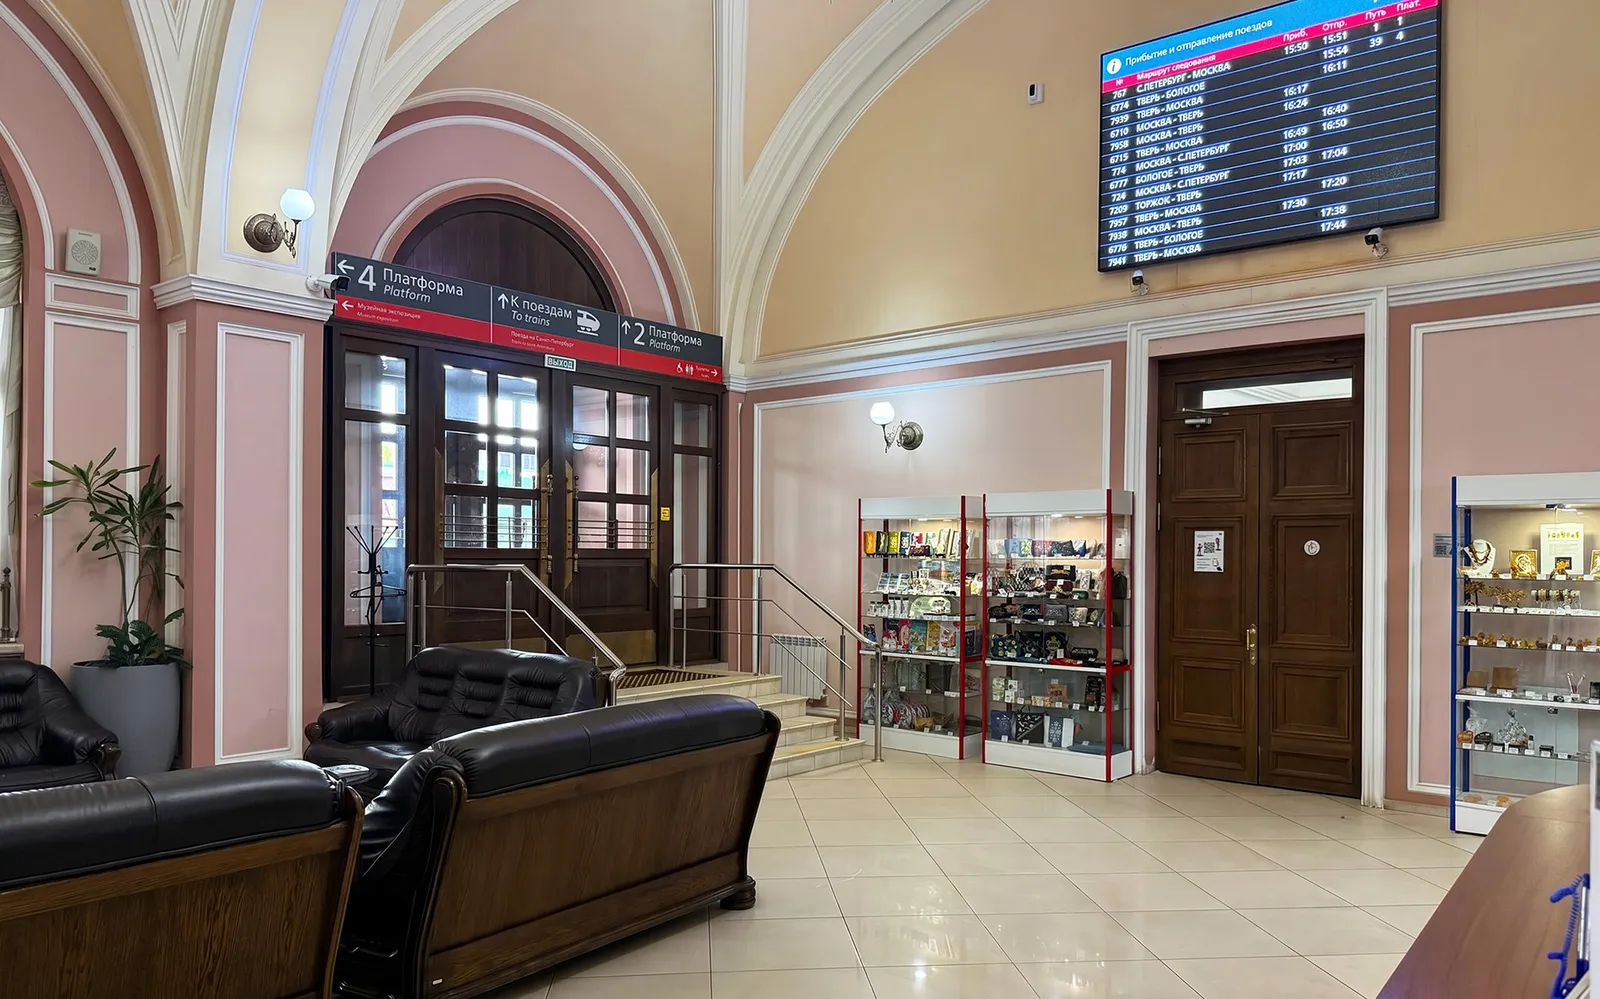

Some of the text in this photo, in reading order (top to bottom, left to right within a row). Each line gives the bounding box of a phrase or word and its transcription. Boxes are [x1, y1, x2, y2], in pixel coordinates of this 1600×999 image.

[1113, 89, 1127, 99] 767
[1136, 73, 1186, 93] С.ПЕТЕРБУРГ
[1192, 62, 1231, 79] МОСКВА
[1284, 41, 1309, 55] 15:50
[1322, 31, 1347, 45] 15:51
[1373, 22, 1379, 32] 1
[1397, 16, 1403, 26] 1
[1125, 49, 1167, 66] Прибытие
[1176, 31, 1233, 52] отправление
[1235, 20, 1272, 36] поездов
[1136, 67, 1171, 81] Маршрут
[1171, 55, 1216, 71] следования
[1283, 29, 1308, 42] Приб.
[1322, 20, 1347, 32] Отпр.
[1365, 9, 1387, 20] Путь
[1396, 0, 1421, 12] Плат.
[1110, 114, 1129, 125] 7939
[1136, 106, 1160, 119] ТВЕРЬ
[1166, 96, 1203, 112] МОСКВА
[1323, 60, 1348, 74] 16:11
[1111, 101, 1129, 113] 6774
[1136, 93, 1160, 107] ТВЕРЬ
[1166, 82, 1205, 99] БОЛОГОЕ
[1322, 45, 1348, 59] 15:54
[1369, 37, 1383, 48] 39
[1395, 31, 1404, 41] 4
[1110, 127, 1129, 138] 6710
[1136, 117, 1172, 132] МОСКВА
[1178, 110, 1203, 123] ТВЕРЬ
[1284, 83, 1308, 97] 16:17
[1110, 141, 1129, 151] 7958
[1136, 131, 1172, 145] МОСКВА
[1178, 124, 1203, 137] ТВЕРЬ
[1284, 98, 1309, 111] 16:24
[1110, 153, 1129, 164] 6715
[1136, 145, 1160, 158] ТВЕРЬ
[1165, 136, 1203, 151] МОСКВА
[1322, 103, 1348, 117] 16:40
[1109, 179, 1128, 190] 6777
[1136, 169, 1173, 184] БОЛОГОЕ
[1180, 163, 1205, 175] ТВЕРЬ
[1283, 141, 1308, 153] 17:00
[1111, 166, 1126, 177] 774
[1136, 157, 1171, 171] МОСКВА
[1178, 143, 1230, 161] С.ПЕТЕРБУРГ
[1283, 126, 1308, 140] 16:49
[1322, 118, 1348, 131] 16:50
[1109, 205, 1128, 215] 7209
[1135, 196, 1170, 211] ТОРЖОК
[1177, 190, 1202, 202] ТВЕРЬ
[1282, 169, 1307, 182] 17:17
[1111, 192, 1126, 202] 724
[1136, 183, 1171, 197] МОСКВА
[1178, 171, 1230, 188] С.ПЕТЕРБУРГ
[1283, 155, 1307, 168] 17:03
[1321, 147, 1348, 160] 17:04
[1108, 231, 1128, 241] 7938
[1135, 222, 1170, 236] МОСКВА
[1177, 217, 1202, 229] ТВЕРЬ
[1282, 198, 1307, 210] 17:30
[1109, 218, 1128, 229] 7957
[1135, 210, 1159, 223] ТВЕРЬ
[1164, 204, 1202, 218] МОСКВА
[1321, 176, 1347, 189] 17:20
[1108, 243, 1127, 254] 6776
[1134, 237, 1158, 249] ТВЕРЬ
[1164, 230, 1203, 244] БОЛОГОЕ
[1320, 205, 1347, 218] 17:38
[1108, 257, 1126, 267] 7941
[1134, 249, 1158, 262] ТВЕРЬ
[1164, 244, 1202, 258] МОСКВА
[1320, 220, 1347, 232] 17:44
[358, 264, 464, 296] 4 Платформа
[383, 284, 431, 303] Platform
[511, 295, 572, 319] К поездам
[511, 310, 550, 327] To trains
[633, 322, 702, 346] 2 Платформа
[649, 339, 681, 353] Platform
[548, 357, 573, 369] ВЫХОД
